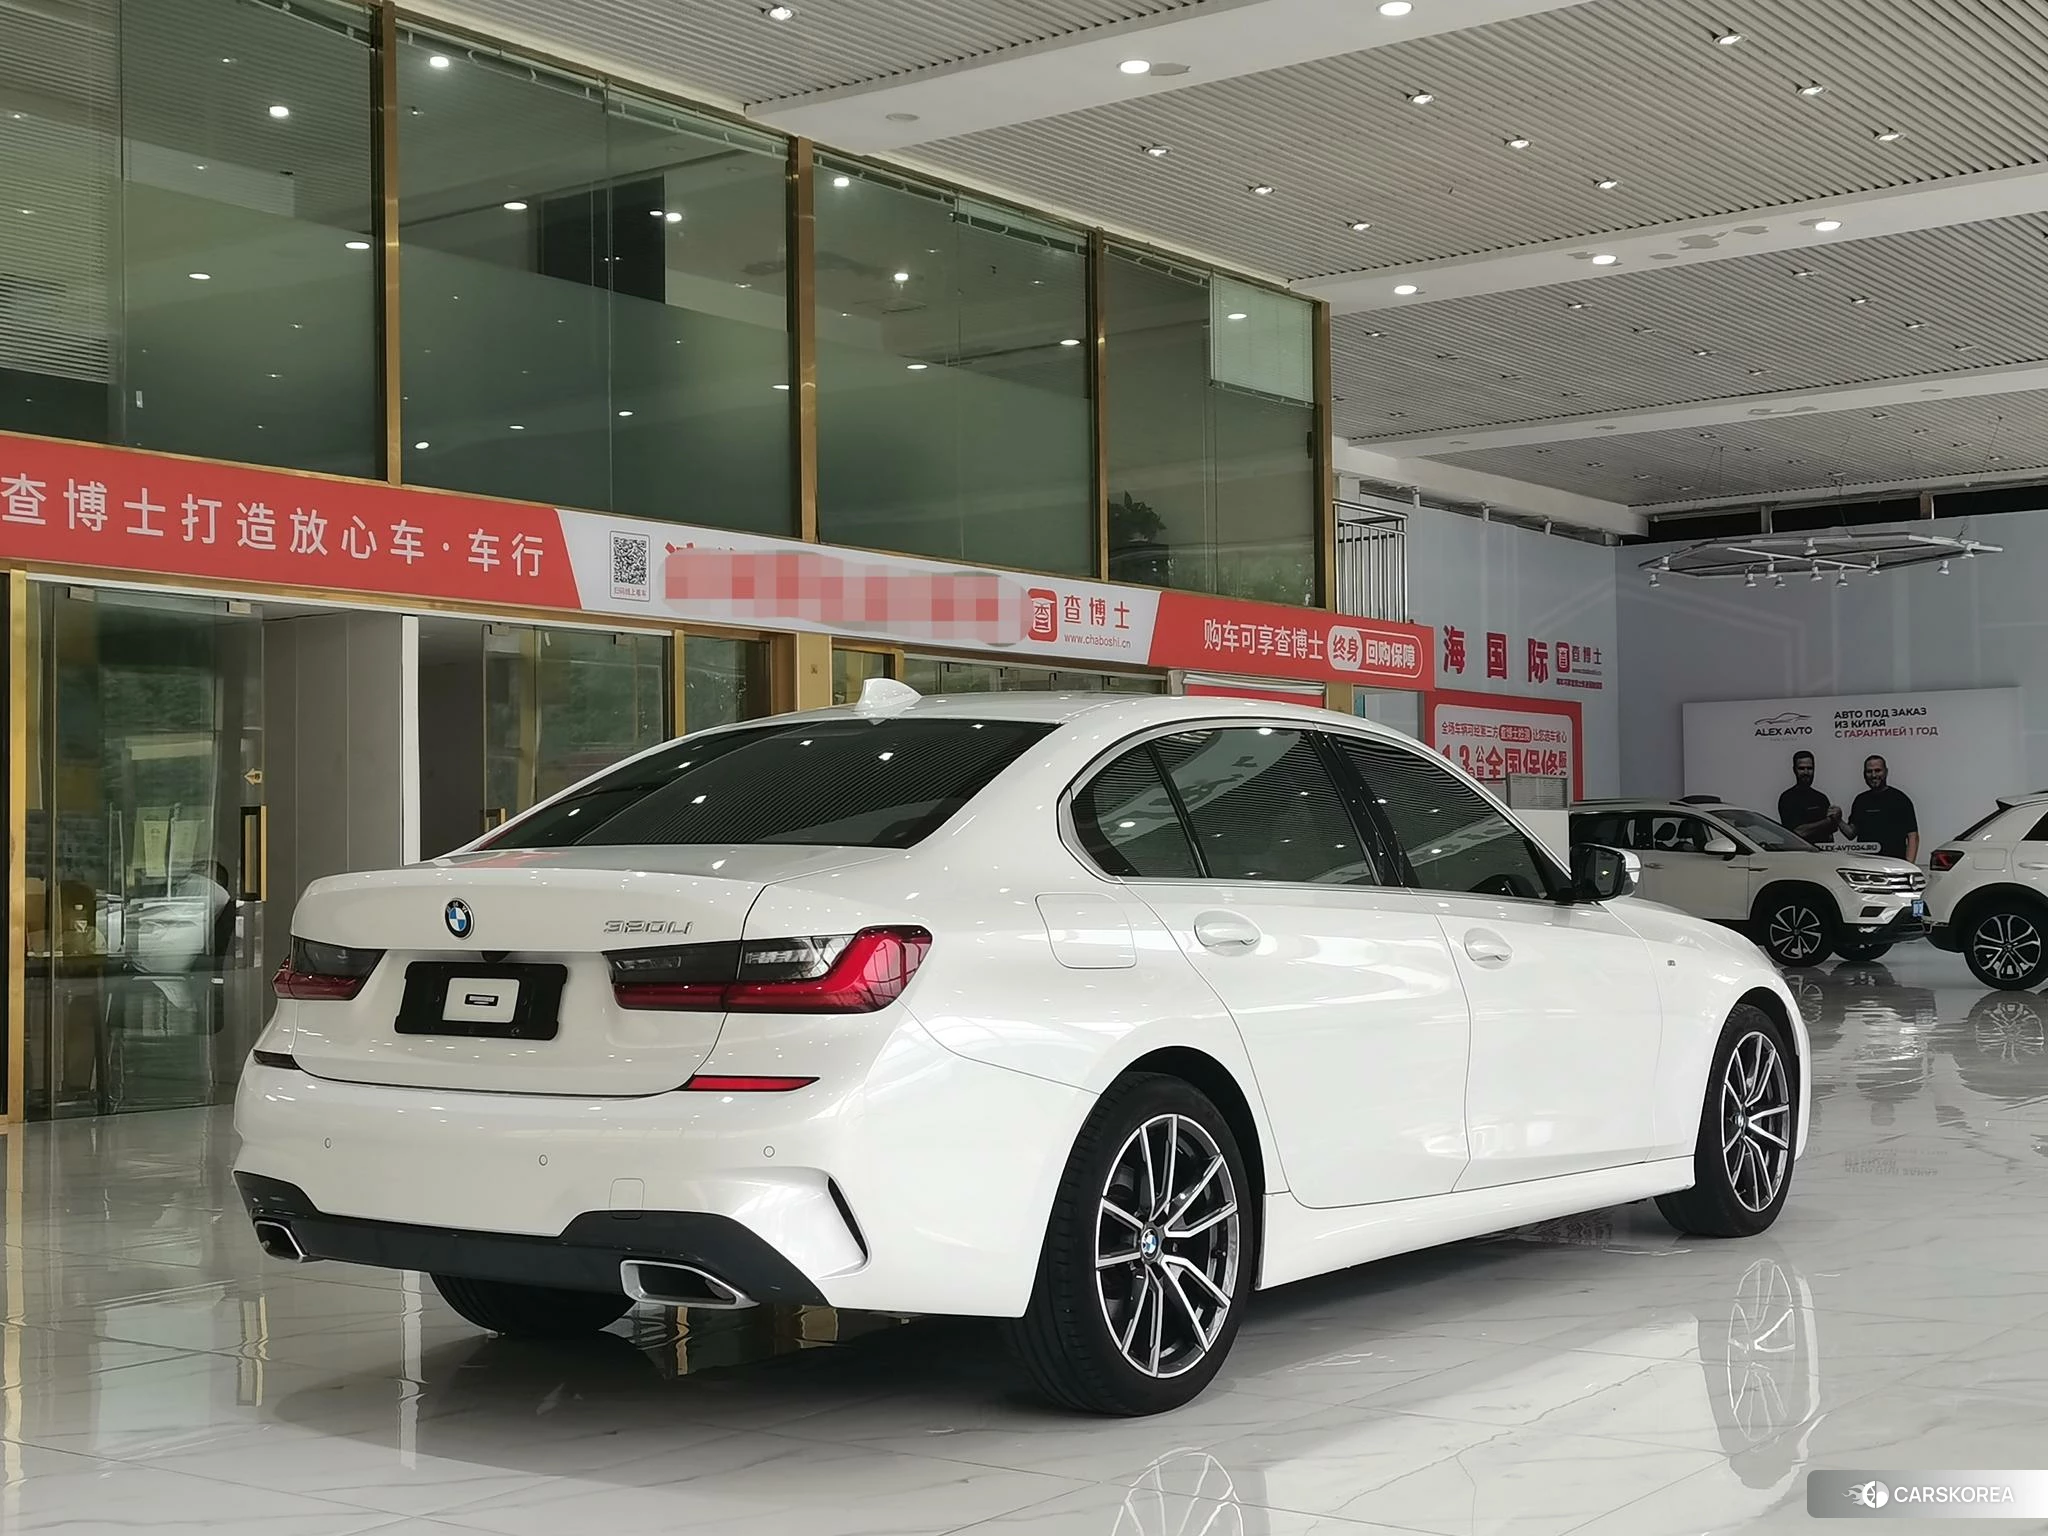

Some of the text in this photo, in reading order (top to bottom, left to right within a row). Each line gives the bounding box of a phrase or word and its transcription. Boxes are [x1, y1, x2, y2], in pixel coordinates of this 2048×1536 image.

[1064, 595, 1130, 630] 查博士
[1064, 633, 1131, 649] www.chaboshi.cn
[1203, 618, 1416, 670] 购车可享查博士 终身 回购保障
[1443, 624, 1548, 684] 海国际
[1834, 707, 1927, 719] АВТО ПОД ЗАКАЗ
[1834, 719, 1886, 729] ИЗ КИТАЯ
[1755, 728, 1782, 736] ALEX
[1844, 727, 1906, 738] ГАРАНТИЕЙ
[1916, 727, 1939, 737] ГОД
